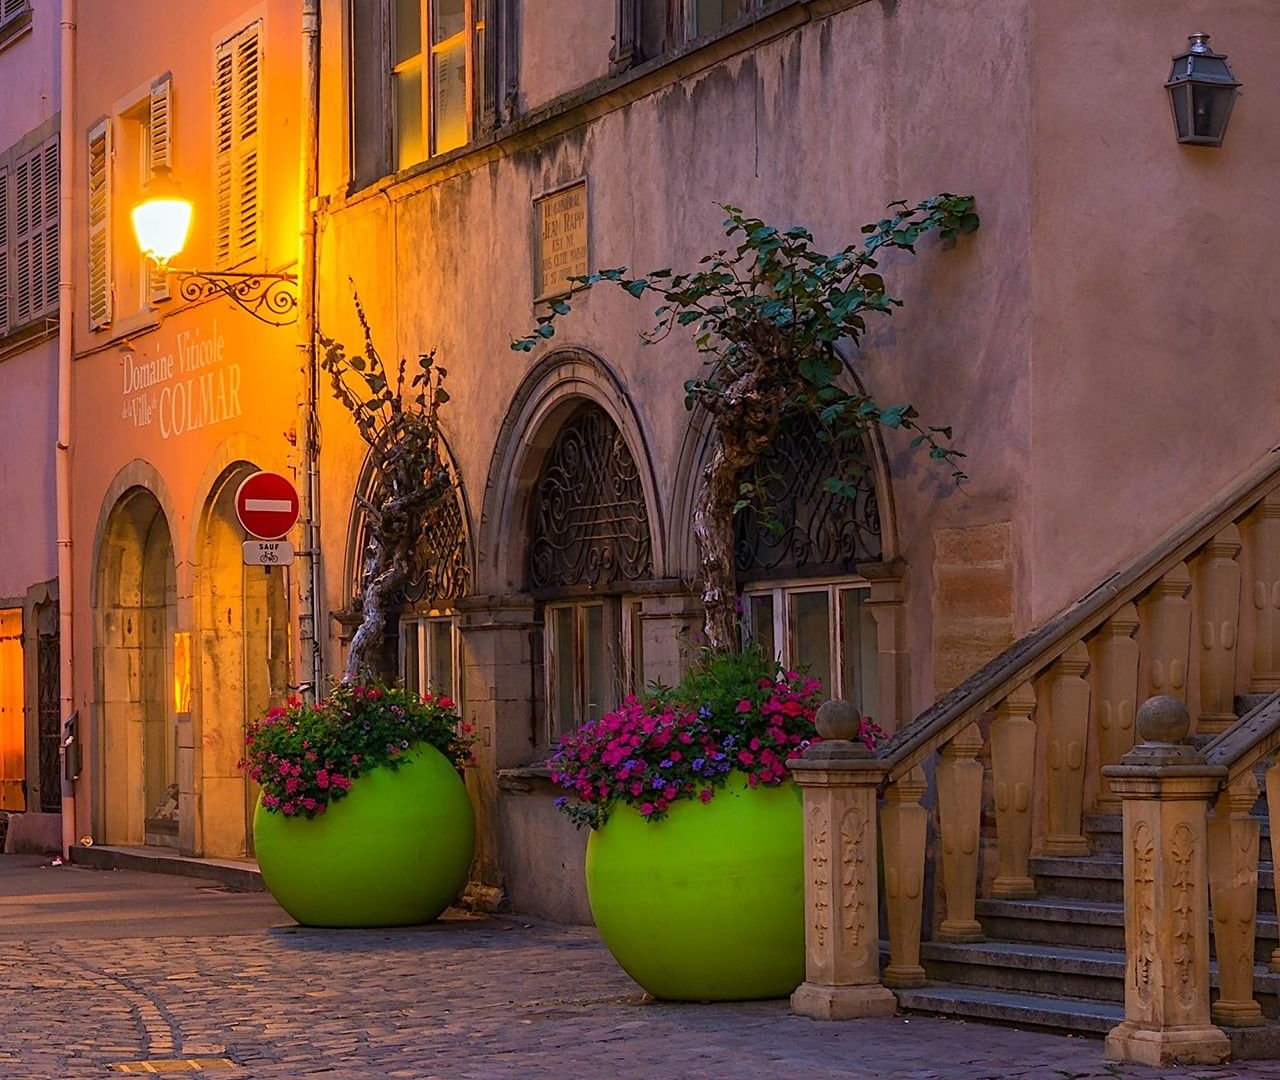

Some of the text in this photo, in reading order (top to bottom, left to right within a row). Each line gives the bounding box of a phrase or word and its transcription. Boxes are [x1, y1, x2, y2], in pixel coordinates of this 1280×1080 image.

[564, 212, 585, 232] RAPP
[122, 318, 225, 395] Domaine Viticole
[131, 393, 152, 427] Ville
[159, 364, 243, 440] COLMAR
[259, 543, 279, 551] SAUF
